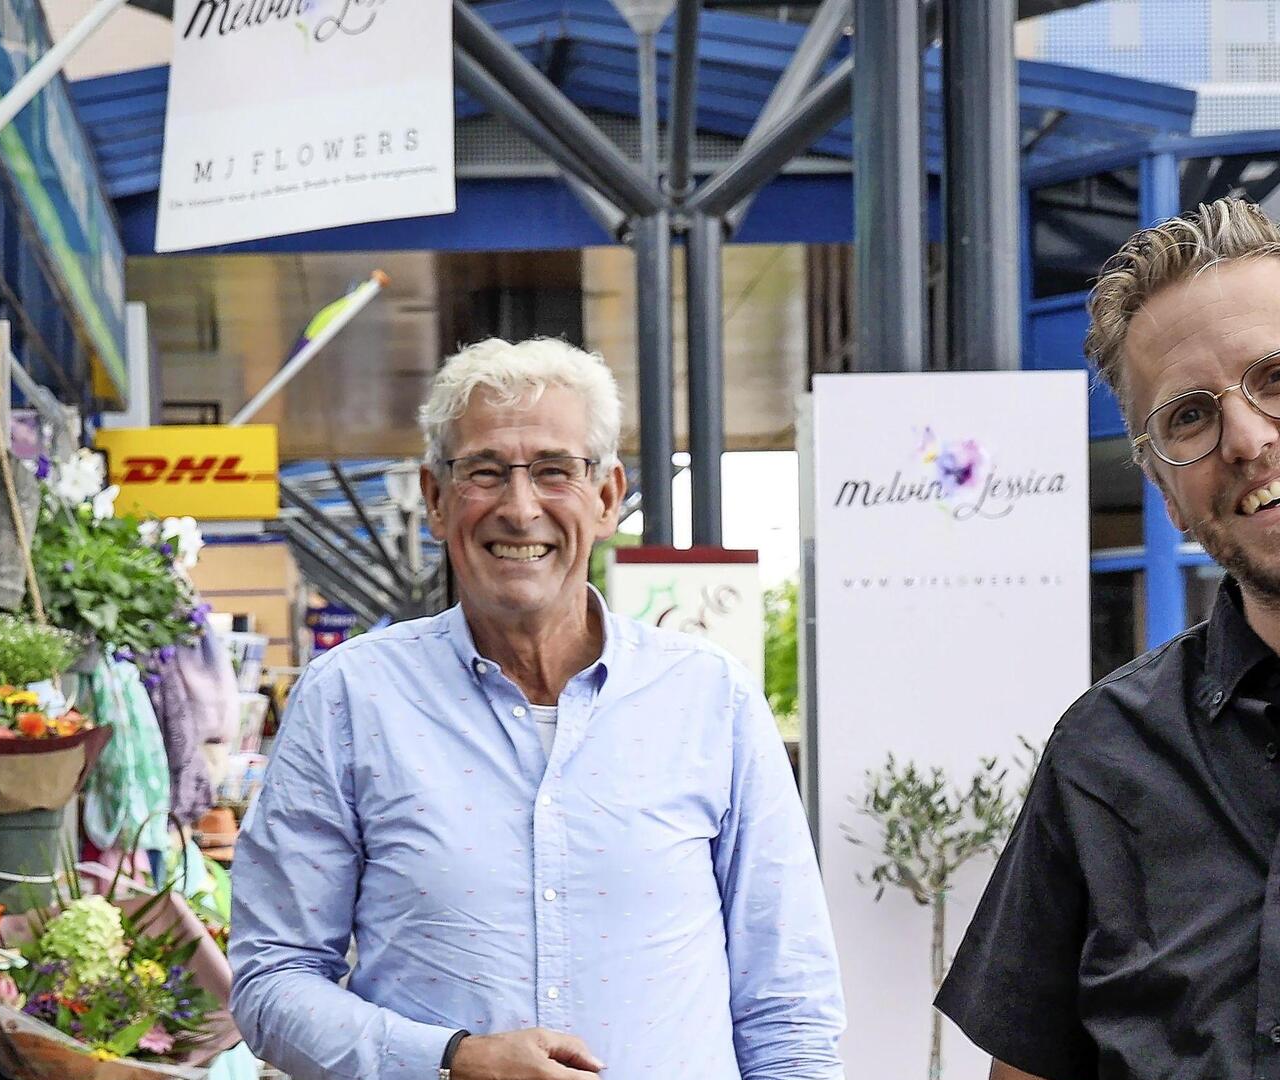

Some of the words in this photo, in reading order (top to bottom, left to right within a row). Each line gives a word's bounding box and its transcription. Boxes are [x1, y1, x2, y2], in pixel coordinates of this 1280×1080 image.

[252, 127, 420, 175] FLOWERS
[122, 456, 249, 484] DHL
[833, 471, 946, 507] Melvin
[953, 465, 1068, 521] Jessica
